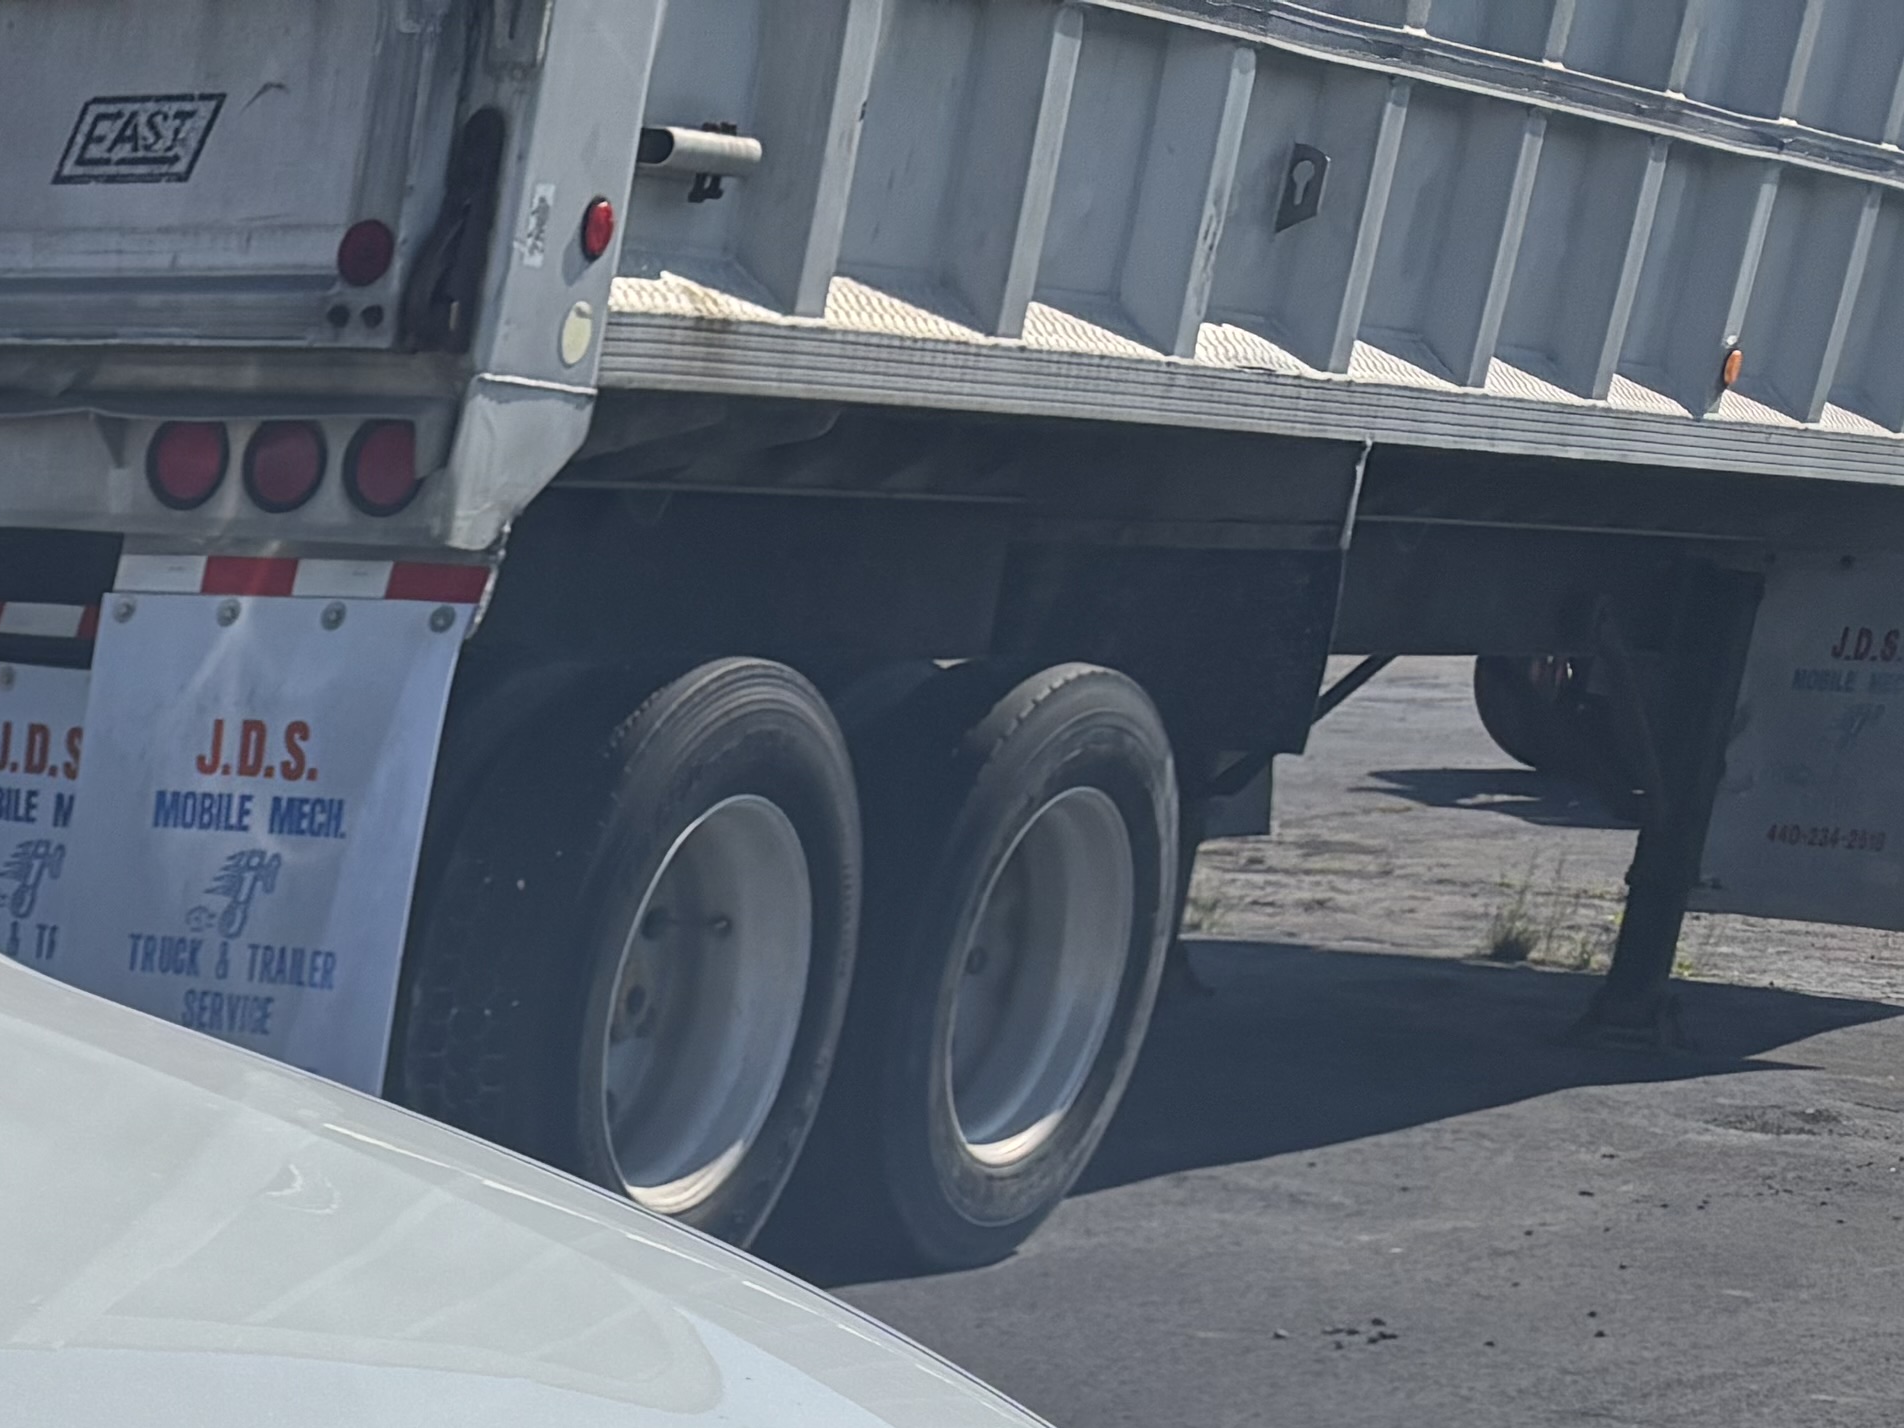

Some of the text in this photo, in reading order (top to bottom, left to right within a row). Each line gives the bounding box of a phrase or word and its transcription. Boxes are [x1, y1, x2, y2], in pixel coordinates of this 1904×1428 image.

[73, 108, 198, 167] EAST
[195, 718, 319, 782] J.D.S.
[151, 790, 347, 840] MOBILE MECH.
[127, 933, 338, 990] TRUCK & TRAILER
[181, 989, 275, 1036] SERVICE
